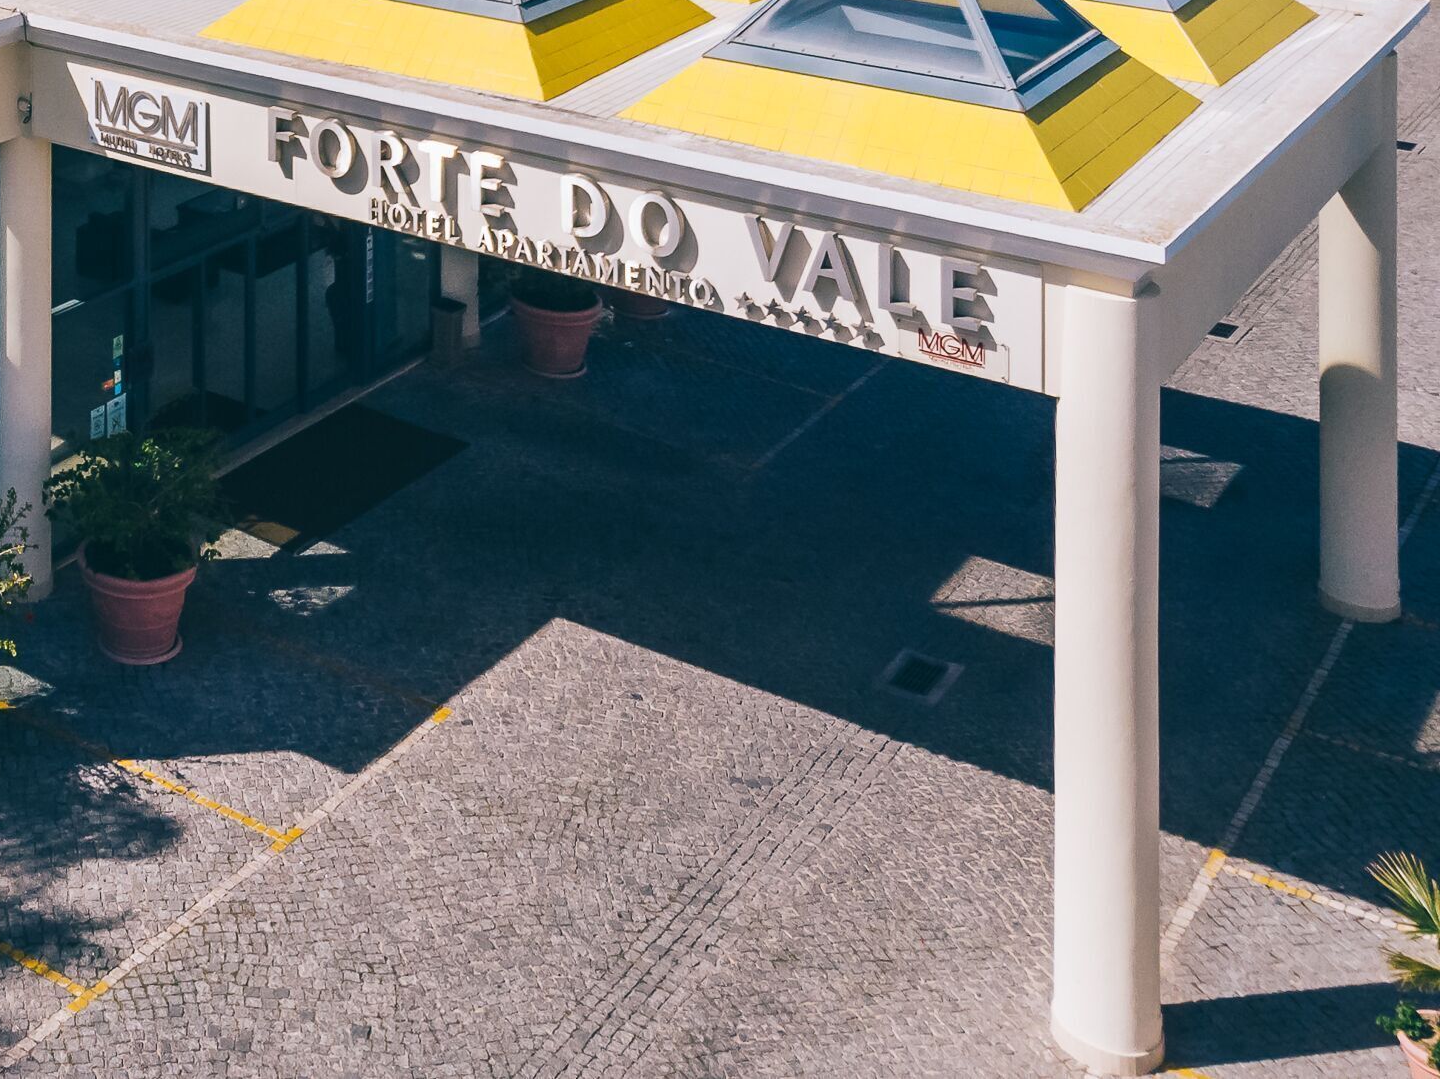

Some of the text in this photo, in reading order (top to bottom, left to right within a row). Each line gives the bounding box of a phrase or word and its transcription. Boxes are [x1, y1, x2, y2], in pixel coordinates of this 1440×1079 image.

[95, 80, 198, 146] MGM
[149, 144, 192, 166] HOTELS
[267, 105, 984, 332] FORTE DO VALE
[368, 197, 715, 307] HOTEL APARTAMENTO
[918, 327, 986, 365] MGM
